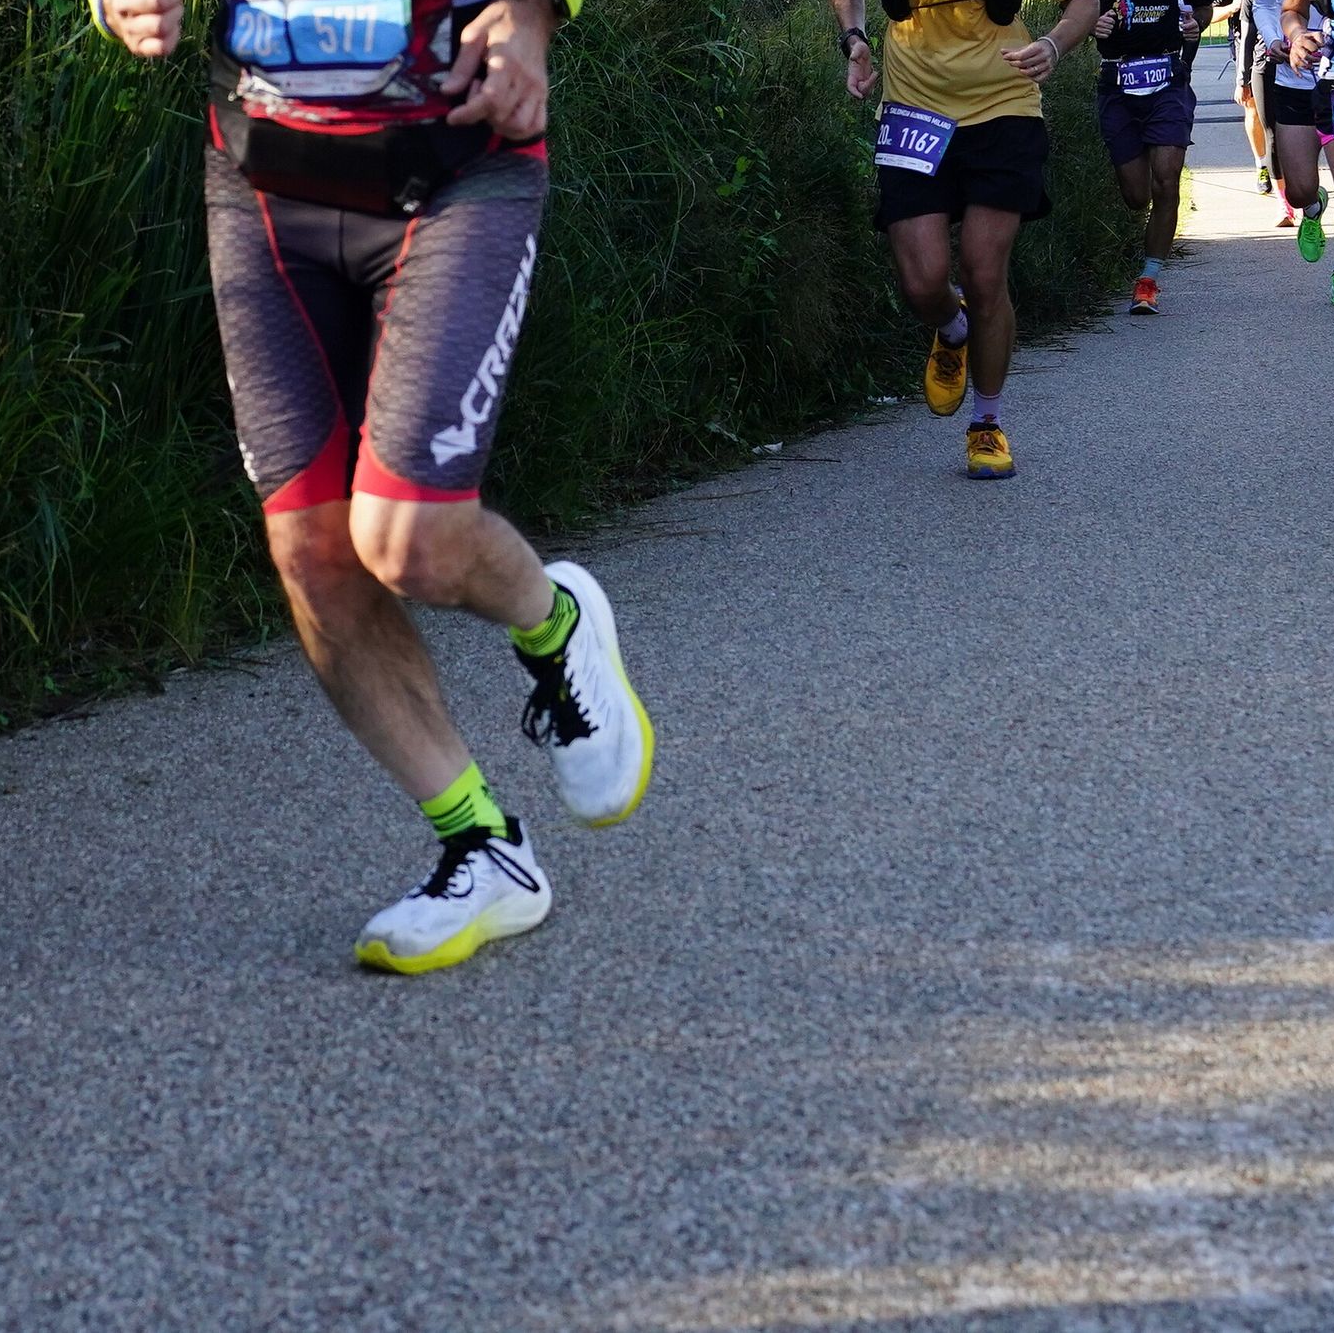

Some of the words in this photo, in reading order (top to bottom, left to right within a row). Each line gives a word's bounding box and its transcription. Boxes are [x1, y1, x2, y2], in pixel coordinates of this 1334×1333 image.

[312, 5, 378, 55] 577
[1144, 68, 1167, 83] 1207
[899, 127, 940, 154] 1167
[460, 233, 537, 425] CRAZY
